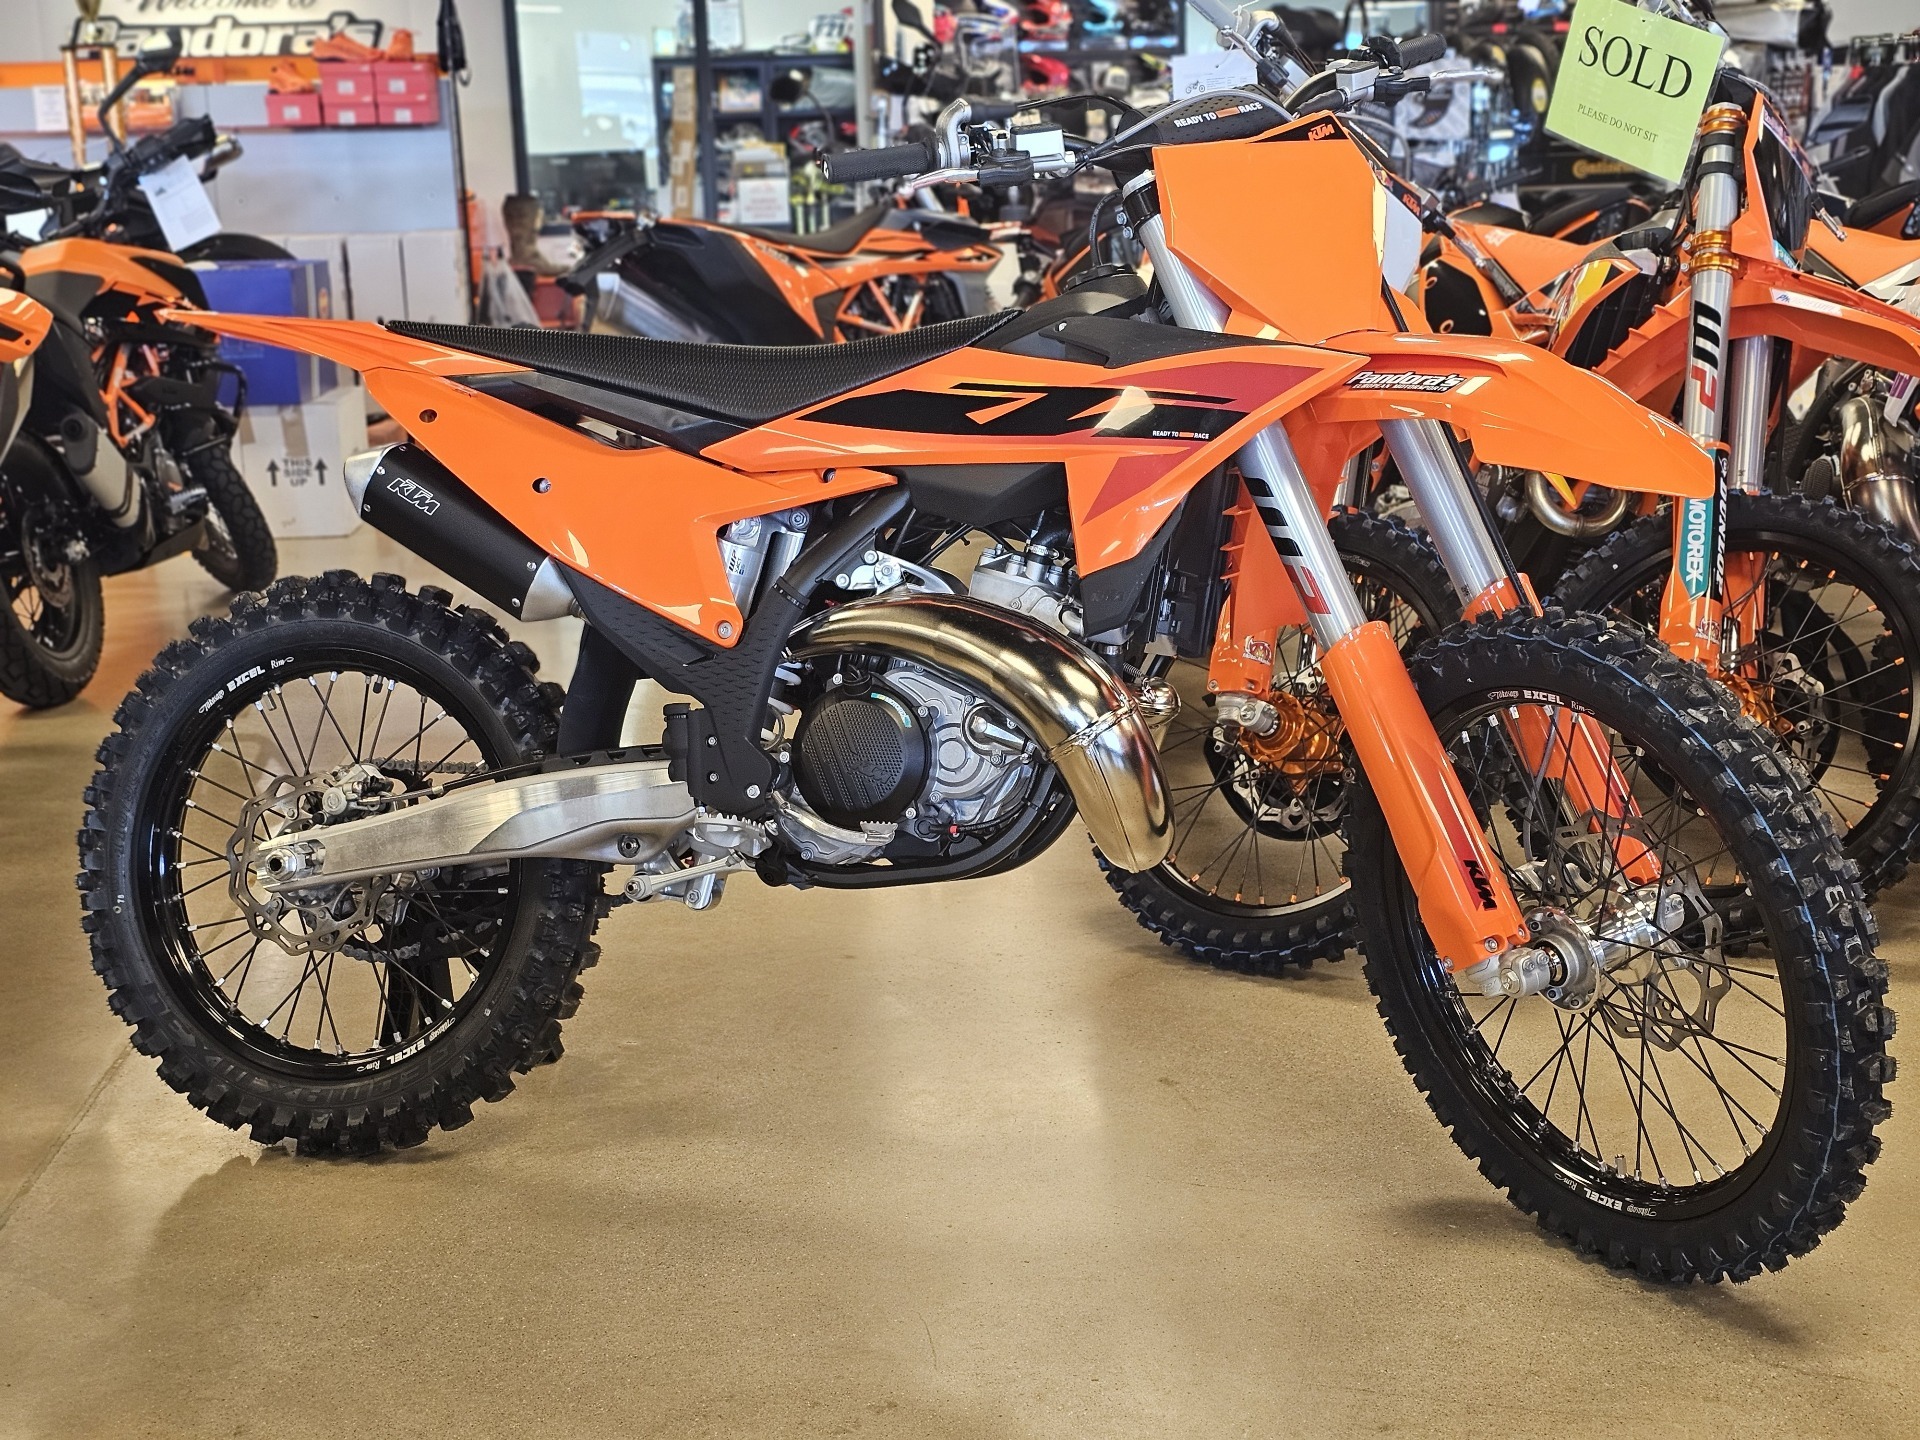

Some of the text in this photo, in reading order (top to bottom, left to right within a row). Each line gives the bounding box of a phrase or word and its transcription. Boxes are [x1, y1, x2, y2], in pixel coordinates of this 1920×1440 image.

[1578, 26, 1692, 99] SOLD
[1173, 102, 1263, 128] READY TO RACE
[1577, 103, 1659, 143] PLEASE DO NOT SIT
[1308, 123, 1335, 141] KTM
[1403, 193, 1420, 216] KTM
[1690, 300, 1722, 413] WP
[1344, 370, 1466, 388] Pandora's
[283, 458, 312, 467] THIS
[283, 468, 312, 477] SIDE
[289, 478, 308, 487] UP
[387, 477, 441, 515] KTM
[1717, 477, 1728, 596] DUNLOP
[728, 549, 737, 572] WP
[226, 665, 266, 692] EXCEL
[270, 656, 294, 669] Rim
[1522, 689, 1564, 705] EXCEL
[1571, 700, 1595, 715] Rim
[1463, 860, 1497, 910] KTM
[386, 1038, 426, 1065] EXCEL
[1583, 1187, 1622, 1211] EXCEL
